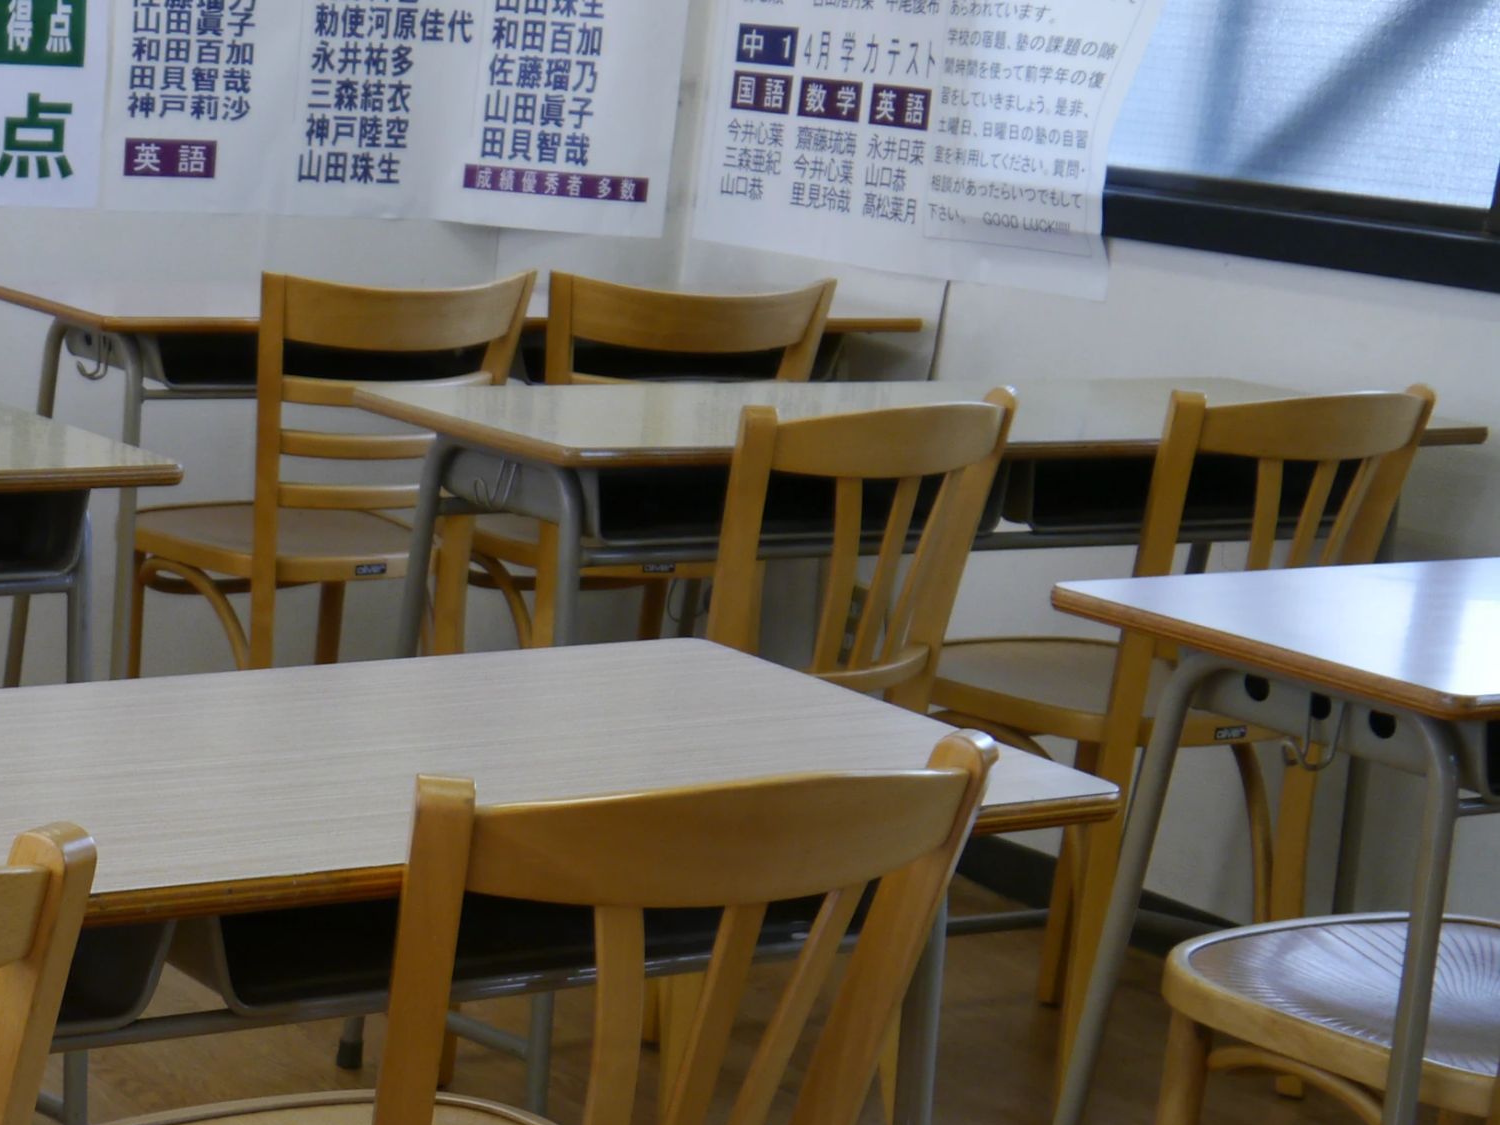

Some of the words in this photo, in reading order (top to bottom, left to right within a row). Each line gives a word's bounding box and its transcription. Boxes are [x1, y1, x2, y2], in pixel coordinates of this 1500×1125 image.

[133, 7, 255, 37] 山田眞子
[315, 3, 474, 44] 勅使河原佳代
[492, 17, 603, 56] 和田百加
[132, 36, 254, 65] 和田百加
[311, 40, 414, 76] 永井祐多
[803, 31, 936, 79] 4月学力テスト
[129, 65, 251, 94] 田貝智哉
[489, 53, 598, 93] 佐藤瑠乃
[128, 92, 251, 121] 神戸莉沙
[308, 78, 412, 113] 三森結衣
[484, 89, 594, 129] 山田眞子
[736, 76, 785, 109] 国語
[805, 83, 856, 116] 数学
[875, 89, 925, 124] 英語
[306, 113, 410, 149] 神戸陸空
[480, 126, 590, 167] 田貝智哉
[133, 143, 206, 173] 英語
[297, 149, 400, 184] 山田珠生
[983, 211, 1019, 229] GOOD
